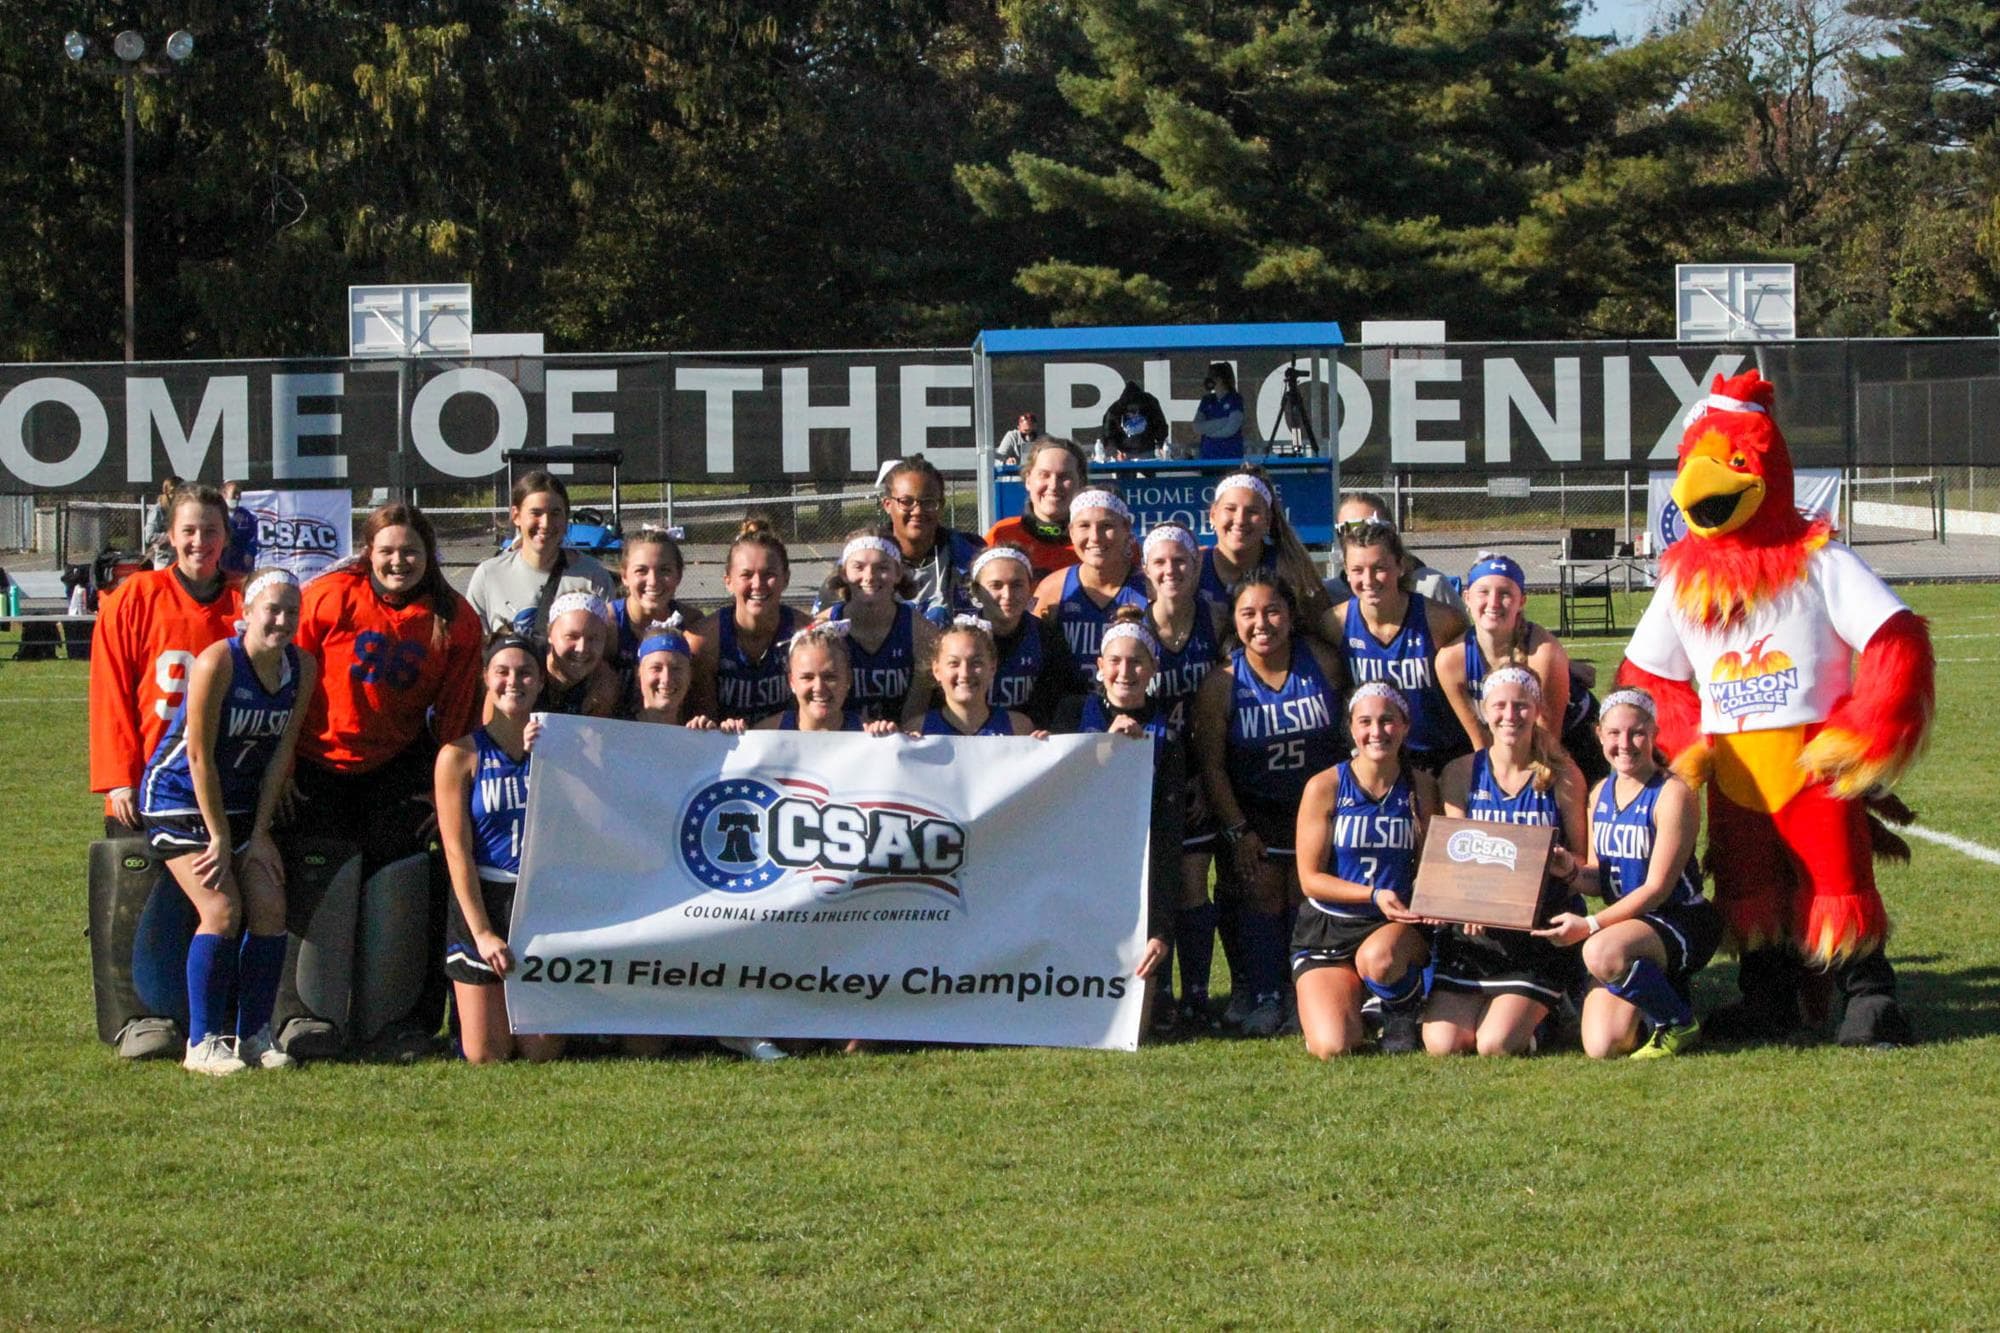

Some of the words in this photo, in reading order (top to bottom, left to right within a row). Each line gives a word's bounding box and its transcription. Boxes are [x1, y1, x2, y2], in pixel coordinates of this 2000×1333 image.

[411, 368, 618, 478] OF
[675, 365, 979, 472] THE
[1126, 487, 1195, 505] HOME
[257, 519, 338, 549] CSAC
[853, 667, 911, 698] ILSON
[1350, 657, 1431, 690] WILSON
[1709, 667, 1799, 703] WILSON
[1239, 693, 1331, 739] WILSON
[1720, 688, 1788, 714] COLLEGE
[233, 740, 258, 768] 7
[1268, 740, 1305, 770] 25
[768, 797, 965, 875] CSAC
[1334, 815, 1415, 850] WILSON
[1470, 838, 1516, 859] CSAC
[683, 905, 757, 921] COLONIAL
[761, 908, 809, 922] STATES
[812, 909, 870, 922] ATHLETIC
[872, 909, 951, 921] CONFERENCE
[521, 955, 613, 985] 2021
[627, 960, 726, 988] Field
[738, 964, 890, 1000] Hockey
[902, 966, 1127, 1003] Champions
